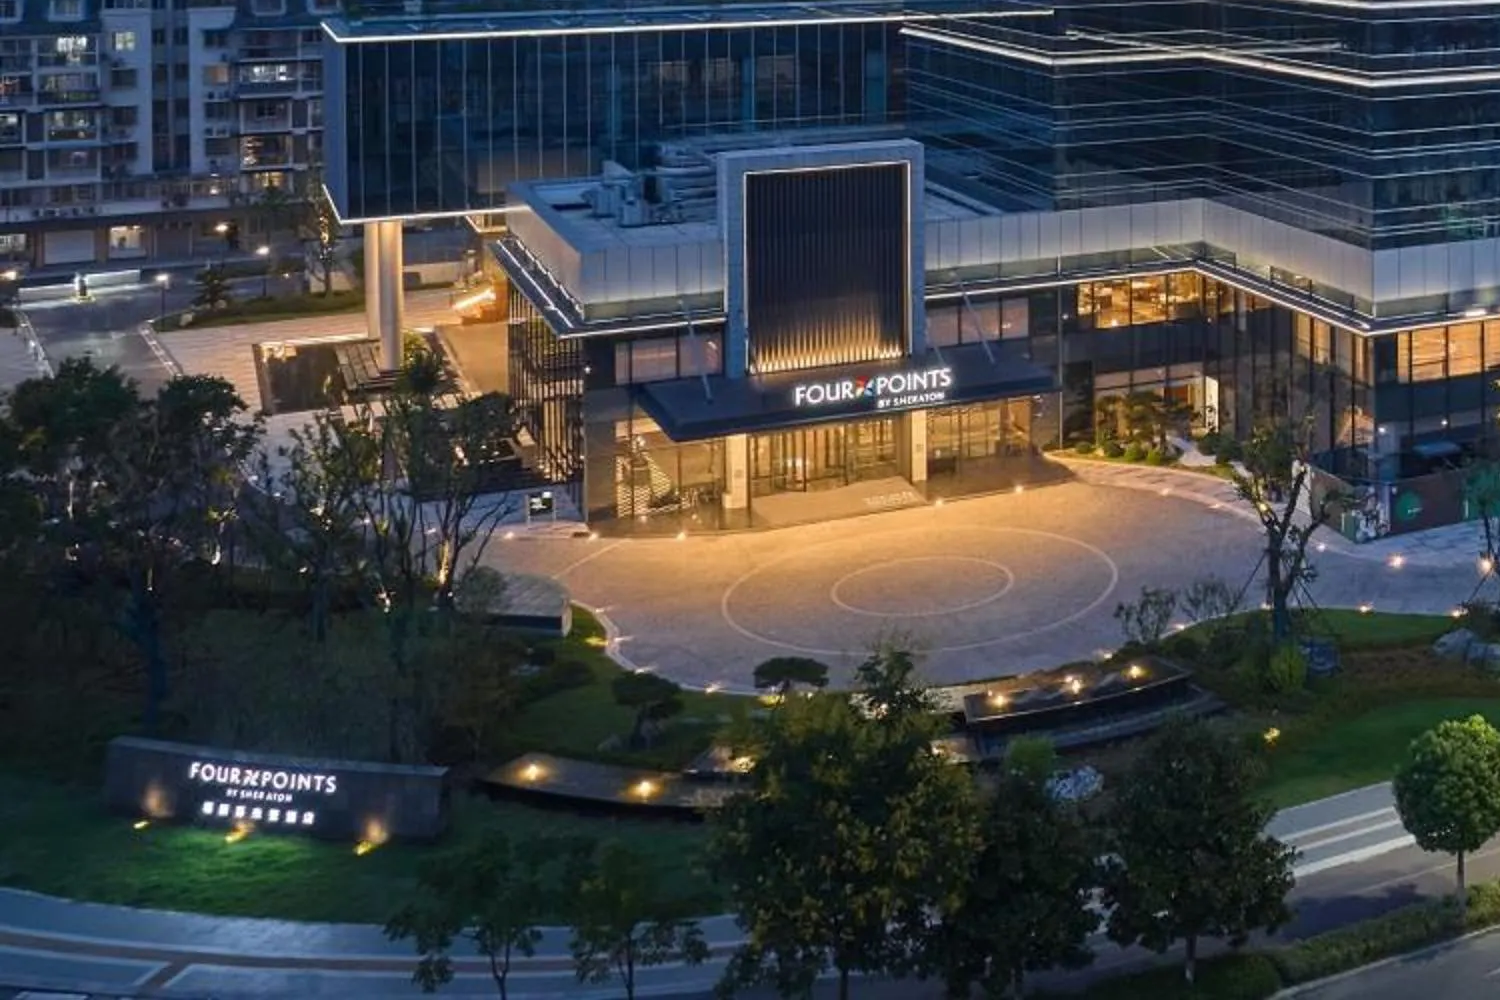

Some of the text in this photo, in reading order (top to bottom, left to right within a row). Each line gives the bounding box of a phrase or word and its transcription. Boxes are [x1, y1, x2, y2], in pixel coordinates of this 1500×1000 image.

[794, 367, 952, 406] FOUR POINTS
[878, 391, 945, 408] BY SHERATON
[188, 761, 337, 794] FOUR POINTS
[226, 788, 293, 803] BY SHERATON
